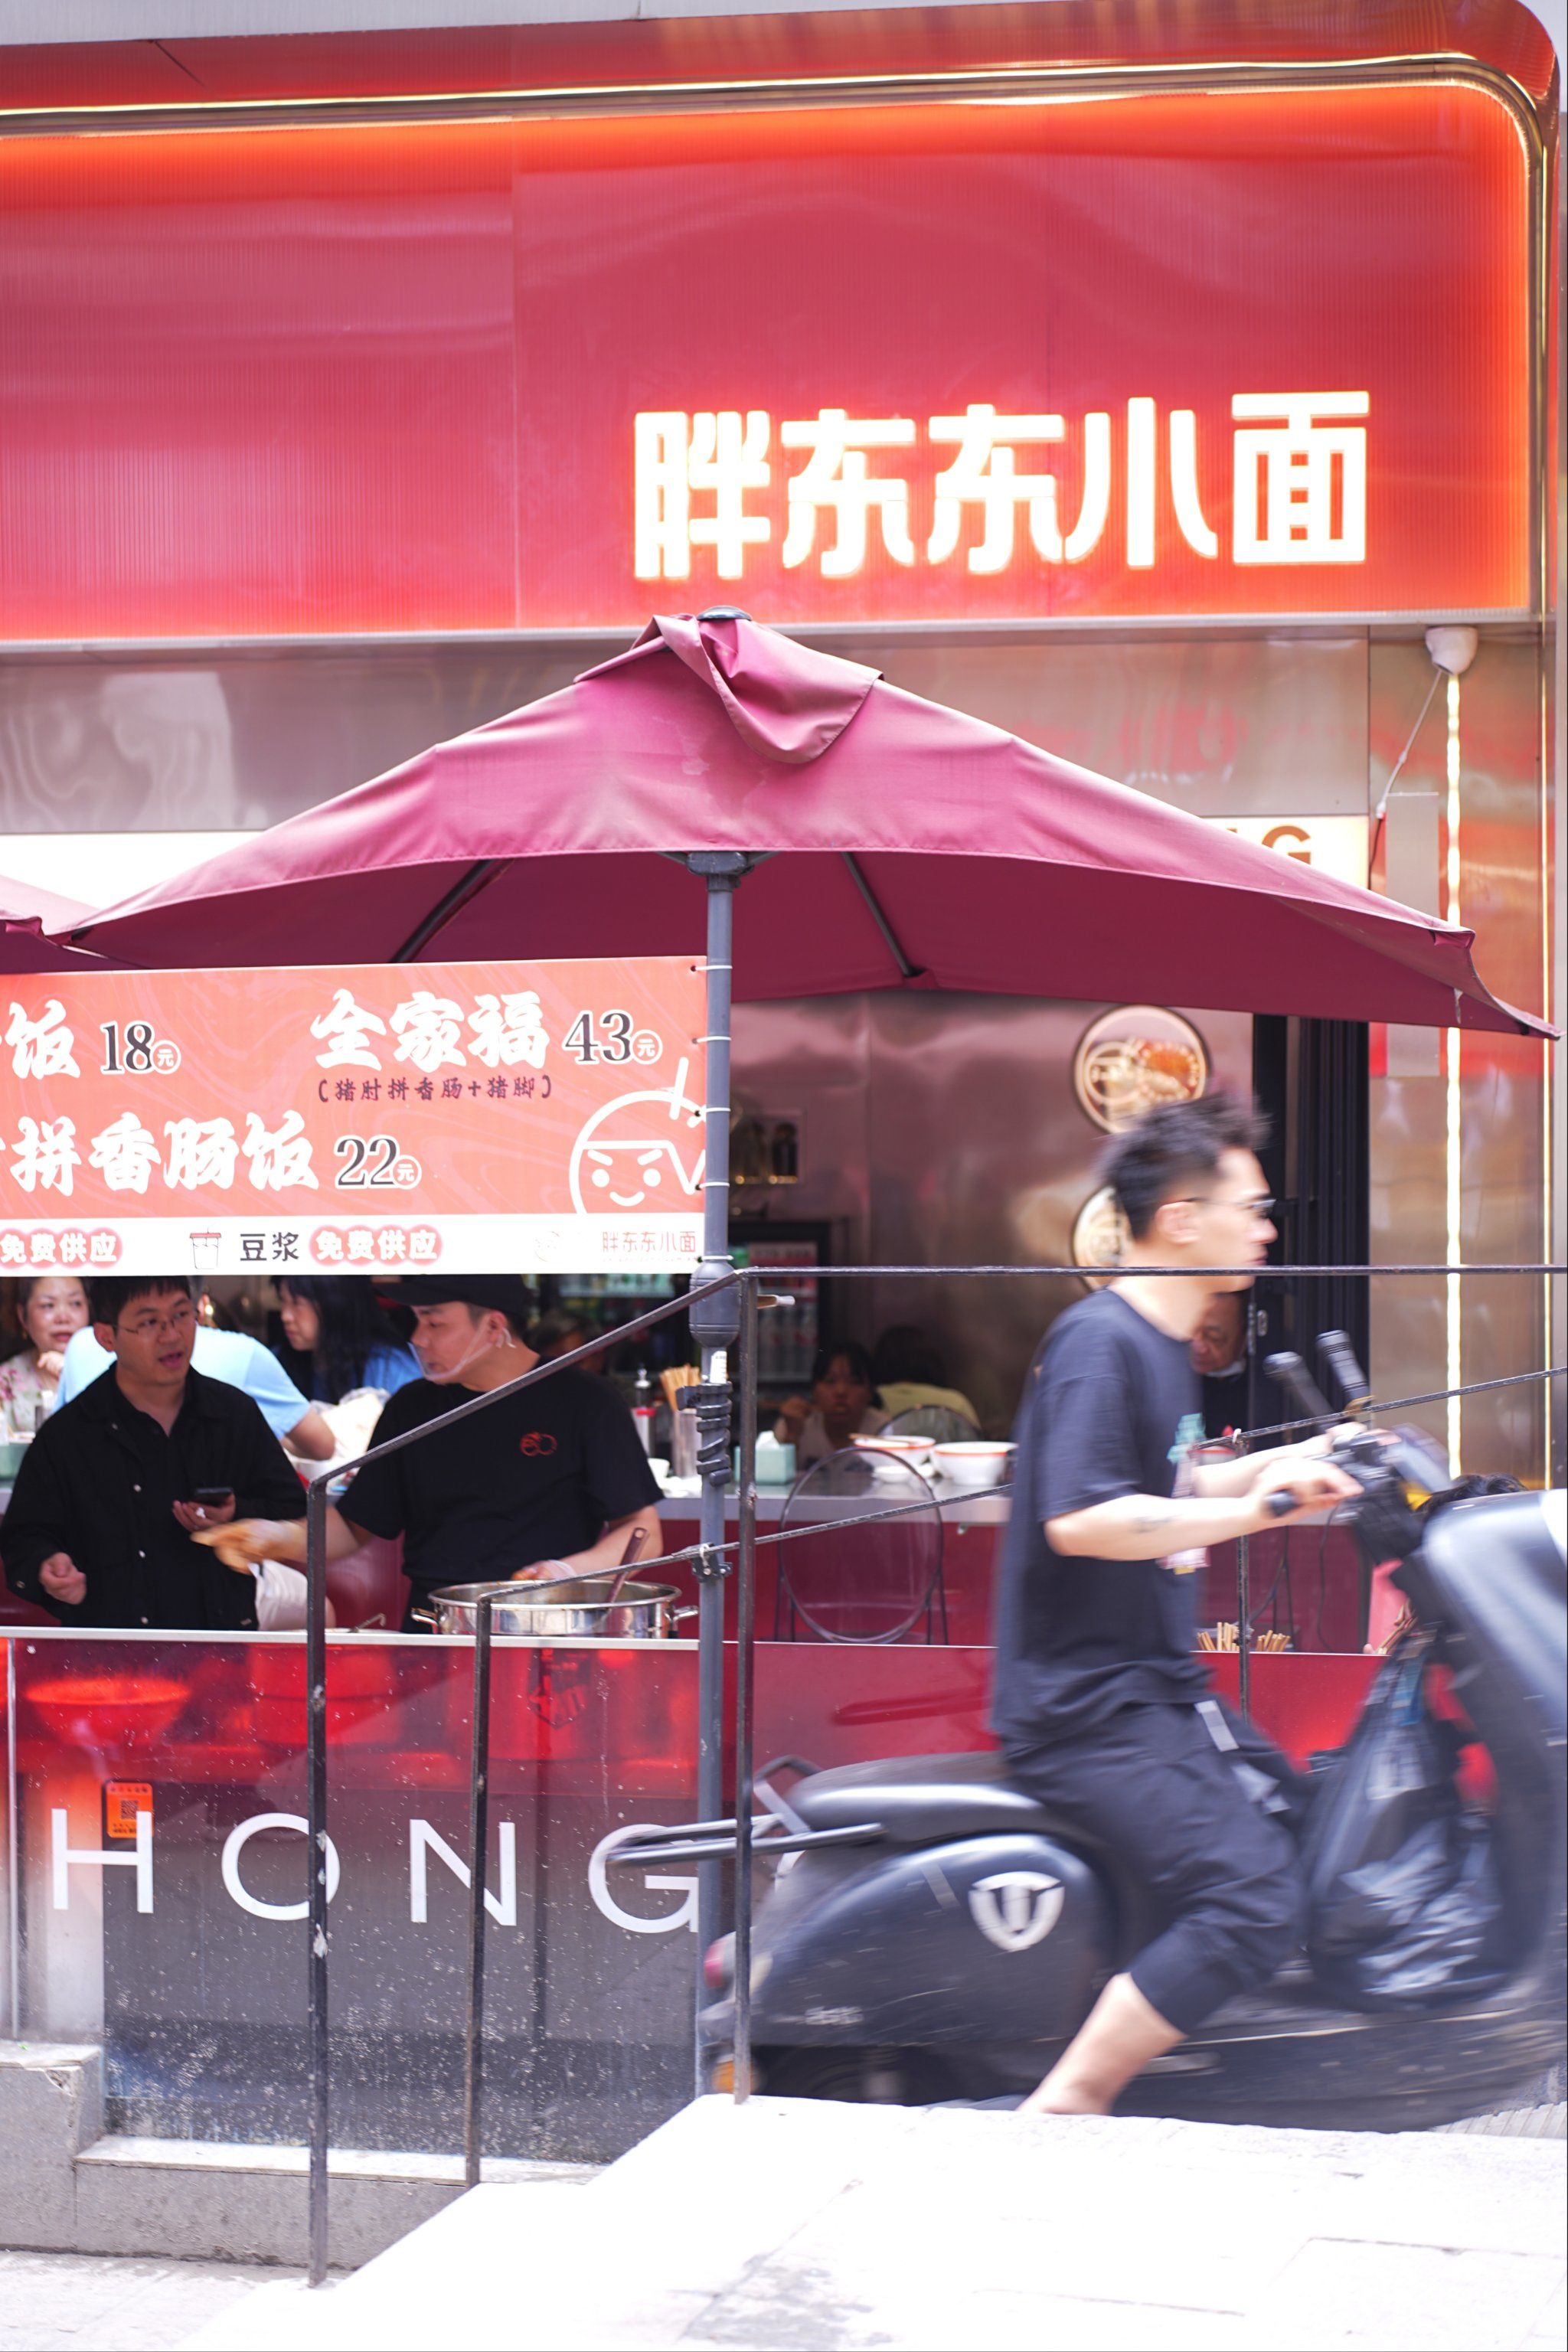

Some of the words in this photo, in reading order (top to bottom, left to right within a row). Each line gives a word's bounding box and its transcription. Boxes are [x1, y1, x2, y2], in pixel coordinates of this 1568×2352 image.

[634, 391, 1369, 579] 胖东东小面
[0, 999, 81, 1080] 饭
[309, 988, 550, 1072] 全家福
[0, 1109, 319, 1197] 拼香肠饭
[0, 1231, 117, 1263] 免费供应
[240, 1232, 299, 1262] 豆浆
[315, 1229, 437, 1261] 免费供应
[603, 1231, 696, 1253] 胖东东小面
[51, 1808, 805, 1934] HONG
